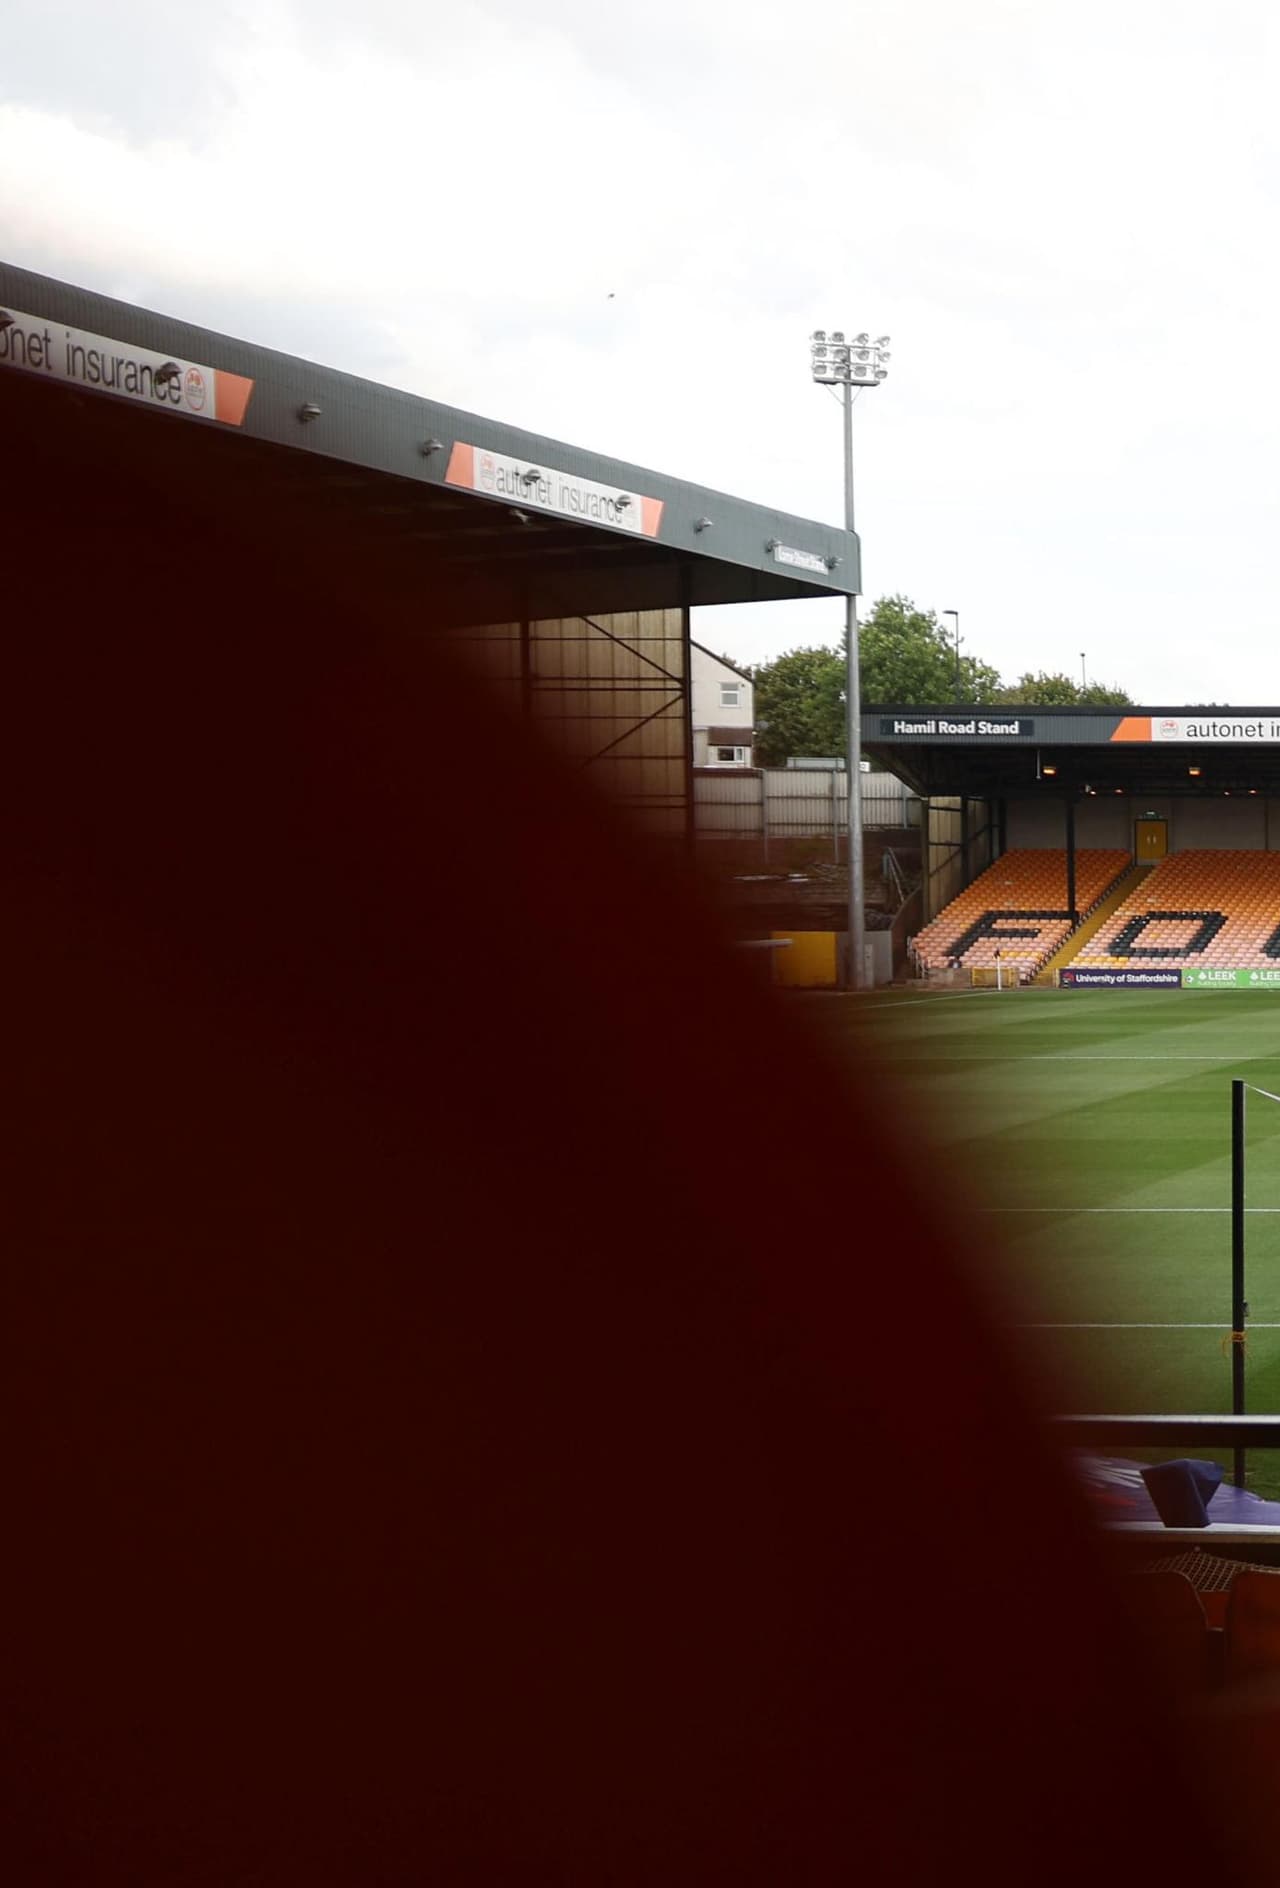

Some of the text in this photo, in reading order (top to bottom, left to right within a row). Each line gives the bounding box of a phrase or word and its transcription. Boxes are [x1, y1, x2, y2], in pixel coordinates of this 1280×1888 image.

[66, 331, 181, 404] insurance
[496, 465, 623, 524] autonet insurance
[894, 720, 1020, 734] Hamil Road Stand
[1186, 721, 1265, 738] autonet
[1076, 974, 1178, 984] University of Staffordshire
[1207, 971, 1236, 981] LEEK
